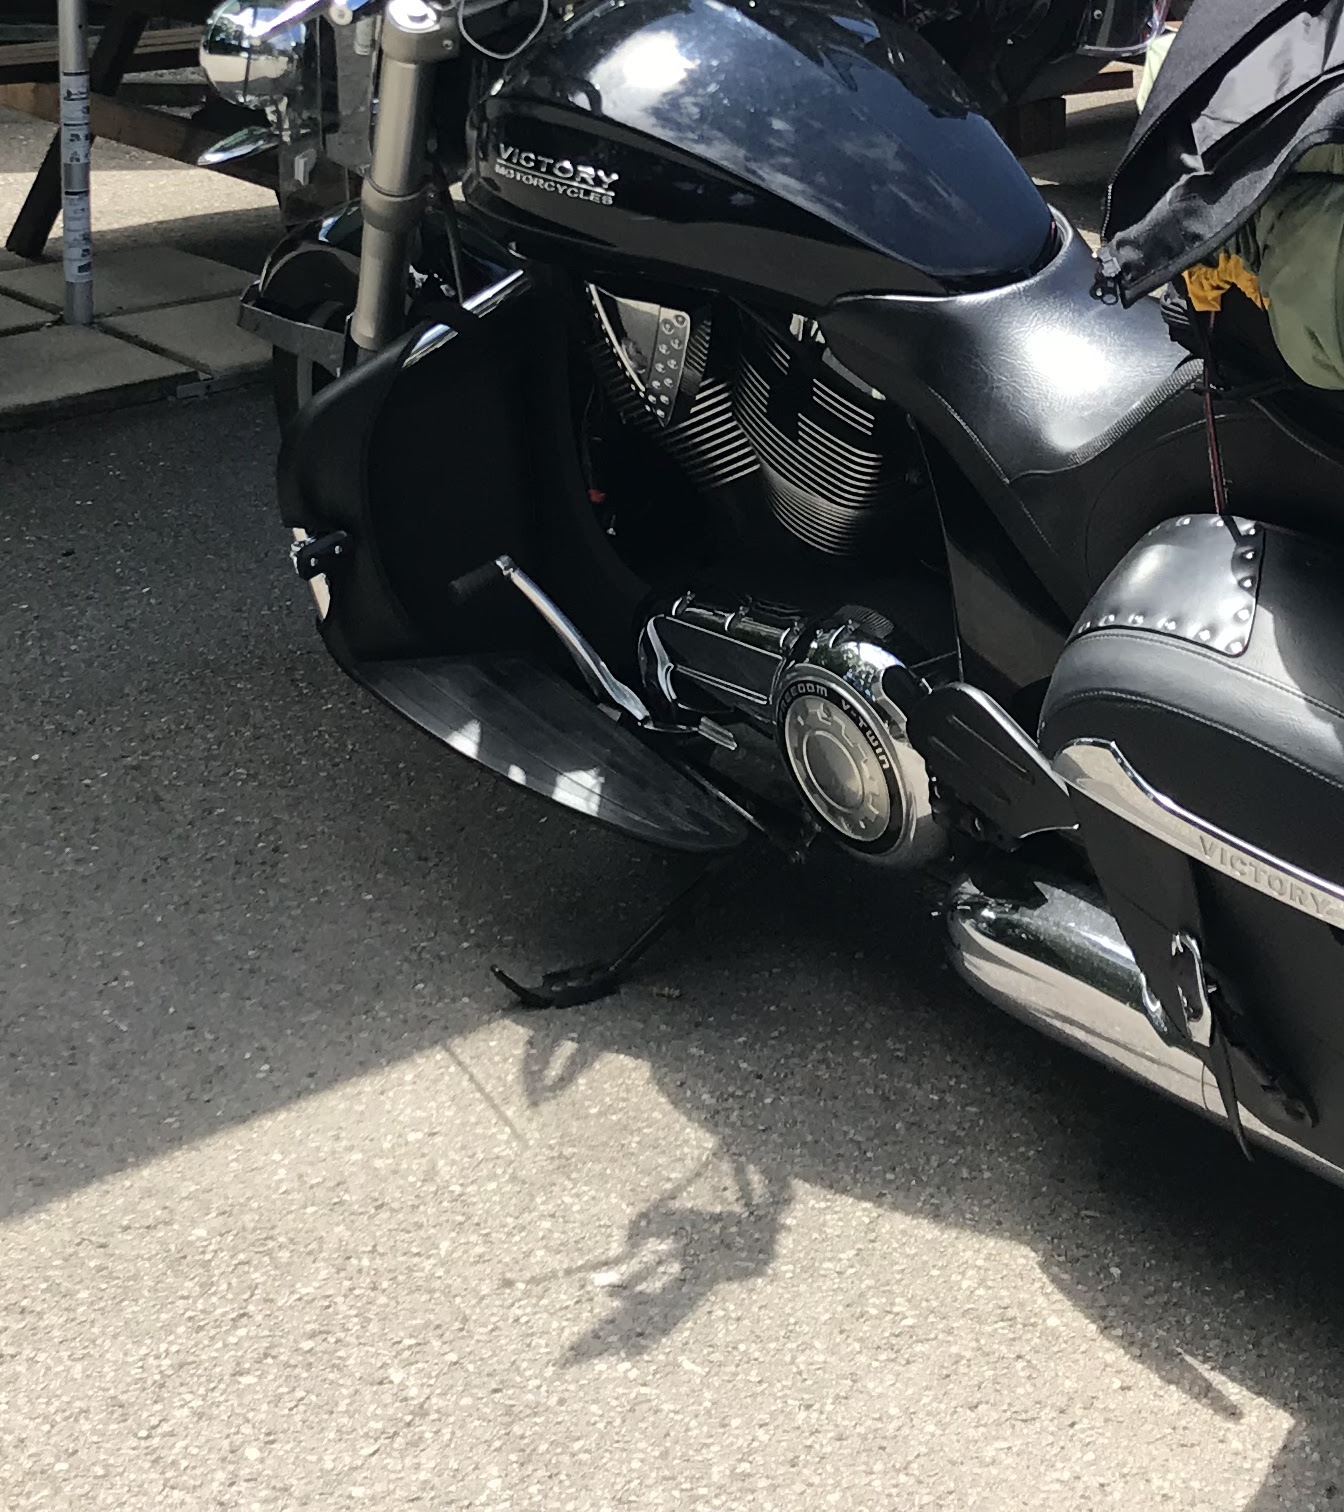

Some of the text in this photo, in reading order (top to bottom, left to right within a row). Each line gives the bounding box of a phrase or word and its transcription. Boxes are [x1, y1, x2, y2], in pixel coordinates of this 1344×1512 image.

[494, 164, 614, 205] MOTORCYCLES
[499, 143, 619, 189] VICTORY
[1199, 834, 1333, 916] VICTORY
